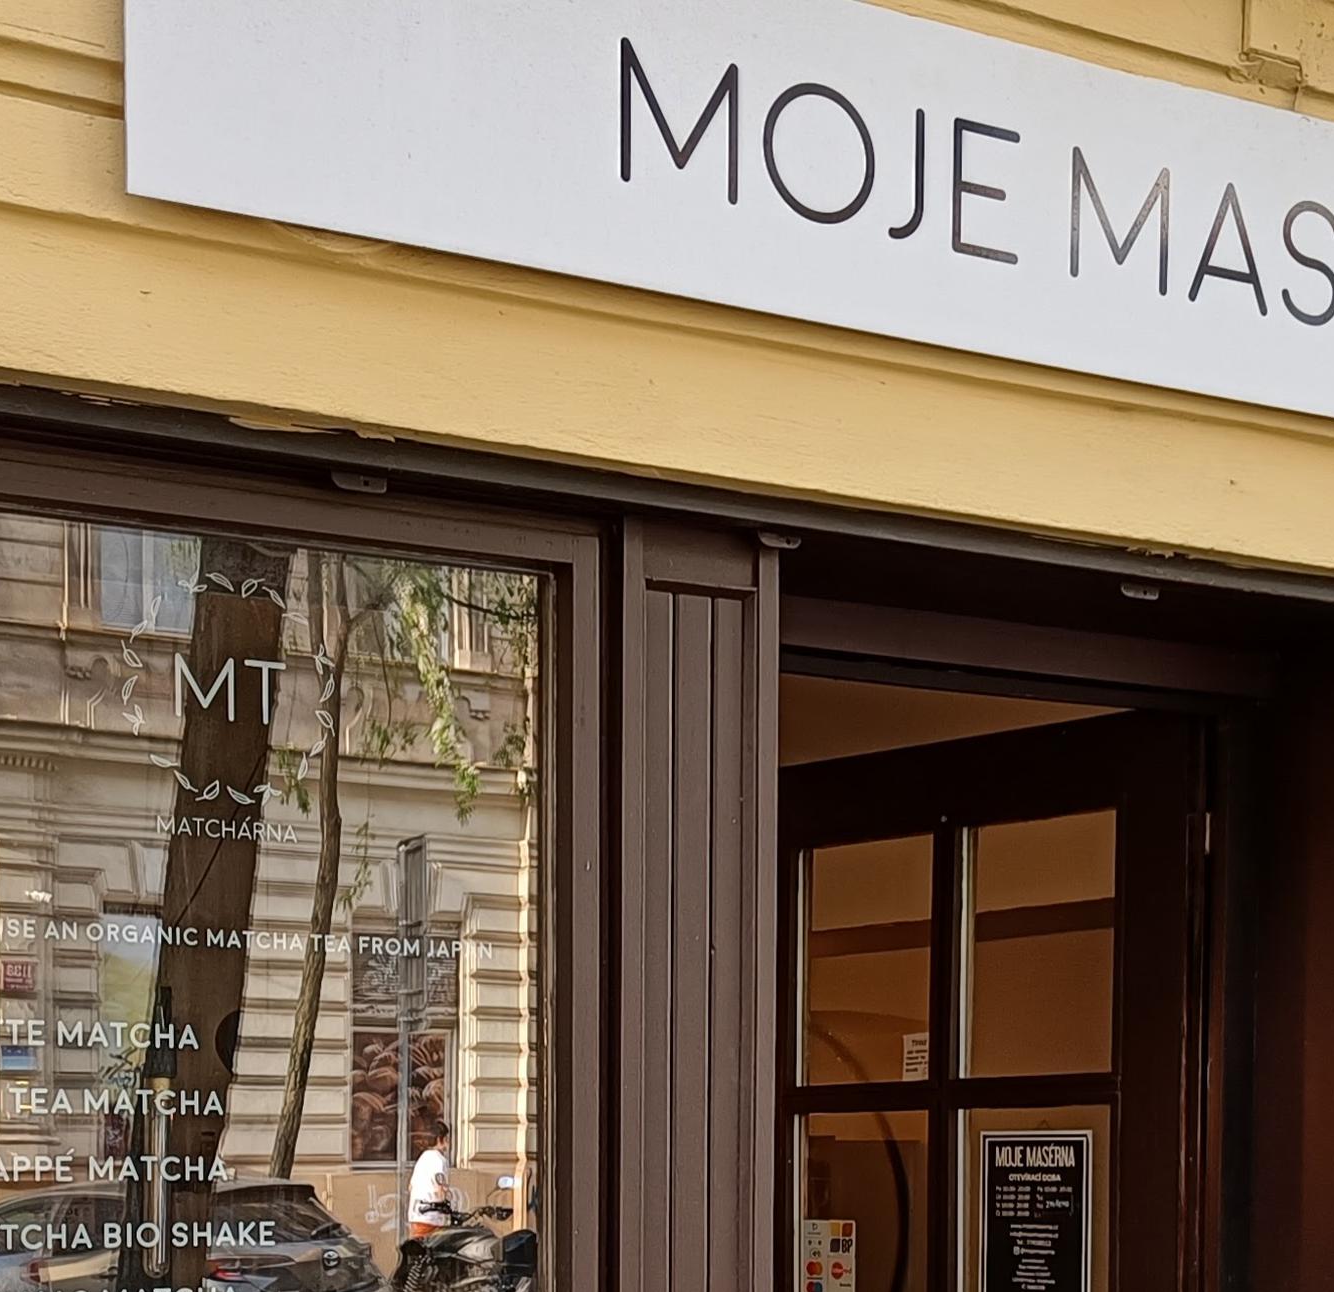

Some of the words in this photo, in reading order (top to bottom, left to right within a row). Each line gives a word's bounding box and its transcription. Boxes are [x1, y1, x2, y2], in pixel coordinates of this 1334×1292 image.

[619, 36, 1021, 268] MOJE
[174, 652, 286, 725] MT
[156, 815, 299, 844] MATCHÁRNA
[44, 921, 78, 941] AN
[86, 923, 199, 946] ORGANIC
[206, 928, 303, 951] MATCHA
[310, 933, 352, 953] TEA
[359, 936, 420, 956] FROM
[57, 1020, 199, 1050] MATCHA
[14, 1088, 79, 1115] TEA
[84, 1088, 224, 1116] MATCHA
[88, 1154, 230, 1183] MATCHA
[995, 1146, 1024, 1167] MOJE
[1026, 1143, 1075, 1167] MASÉRNA
[103, 1222, 161, 1250] BIO
[171, 1220, 276, 1248] SHAKE
